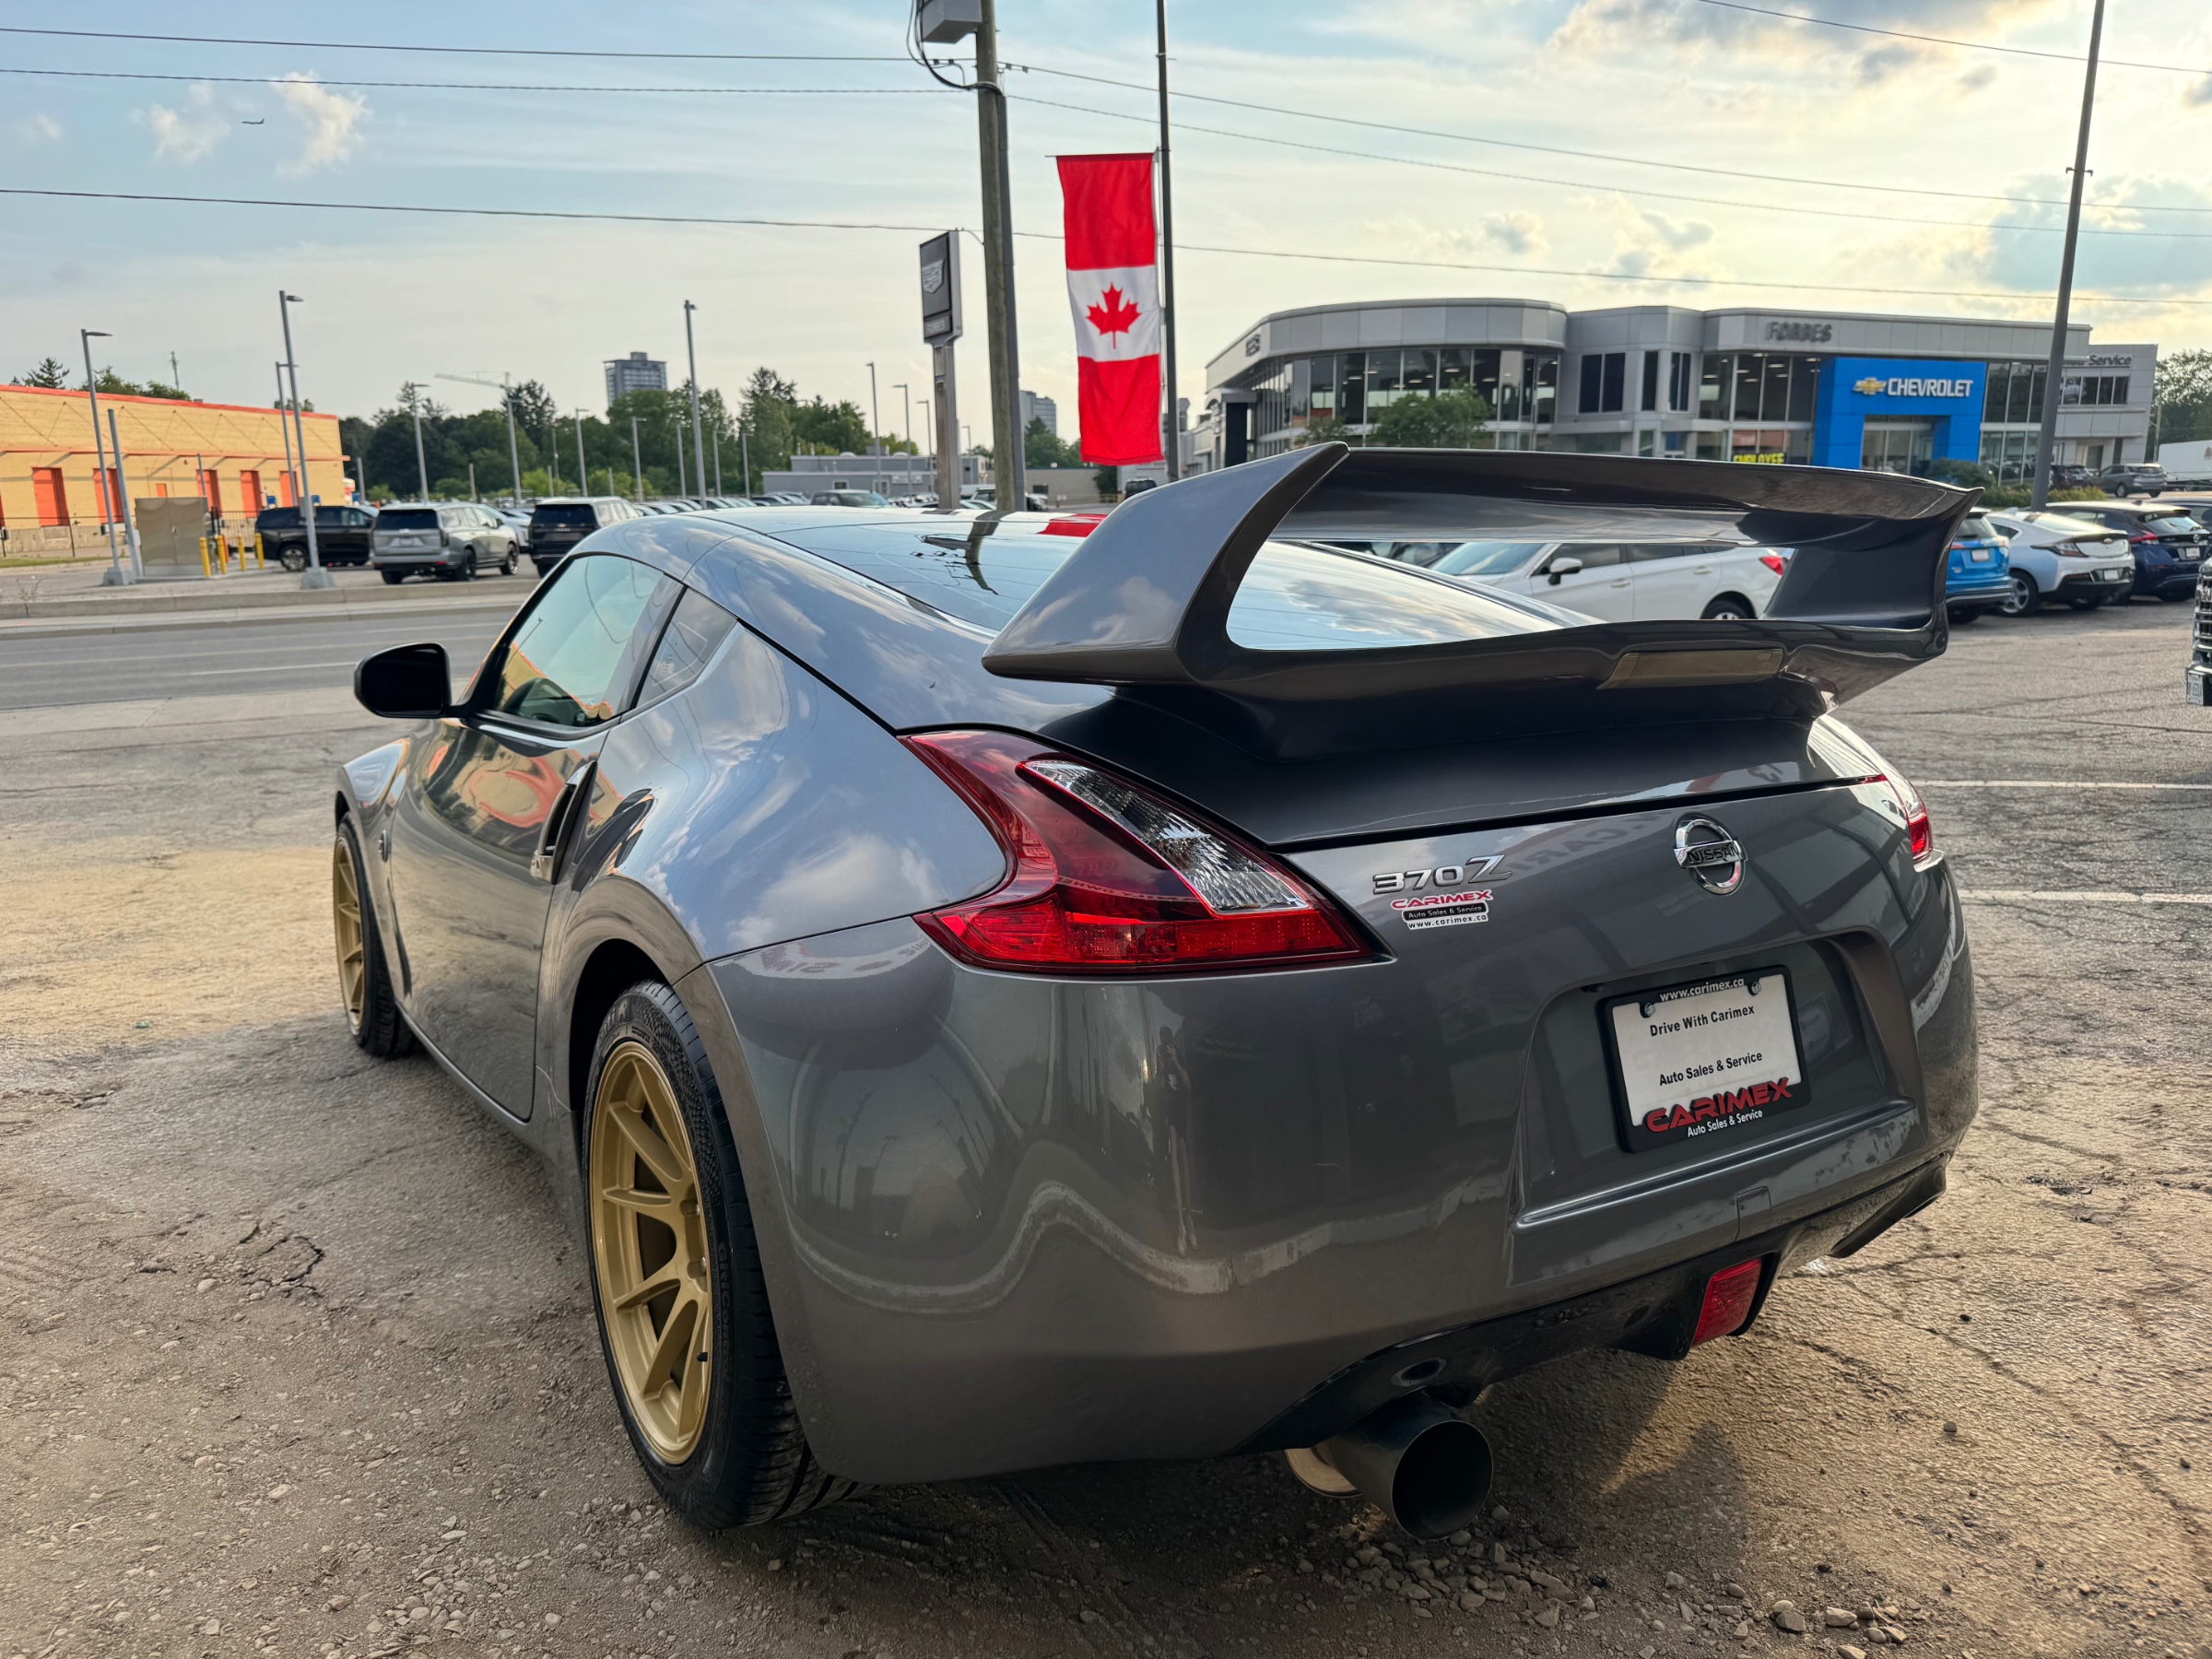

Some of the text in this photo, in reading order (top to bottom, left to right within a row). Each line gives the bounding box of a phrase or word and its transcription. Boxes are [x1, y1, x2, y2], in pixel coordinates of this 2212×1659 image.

[2088, 354, 2132, 366] Service
[1888, 378, 1973, 397] CHEVROLET
[1688, 843, 1739, 863] NISSAN
[1392, 890, 1491, 909] CARIMEX
[1407, 911, 1426, 920] Auto
[1428, 909, 1446, 918] Sales
[1457, 906, 1482, 914] Service
[1408, 914, 1487, 928] www.carimex.ca
[1659, 977, 1745, 1002] www.carimex.ca
[1650, 1005, 1755, 1037] Drive With Carimex
[1659, 1052, 1762, 1087] Auto Sales & Service
[1644, 1077, 1793, 1132] CARIMEX
[1687, 1110, 1763, 1138] Auto Sales & Service
